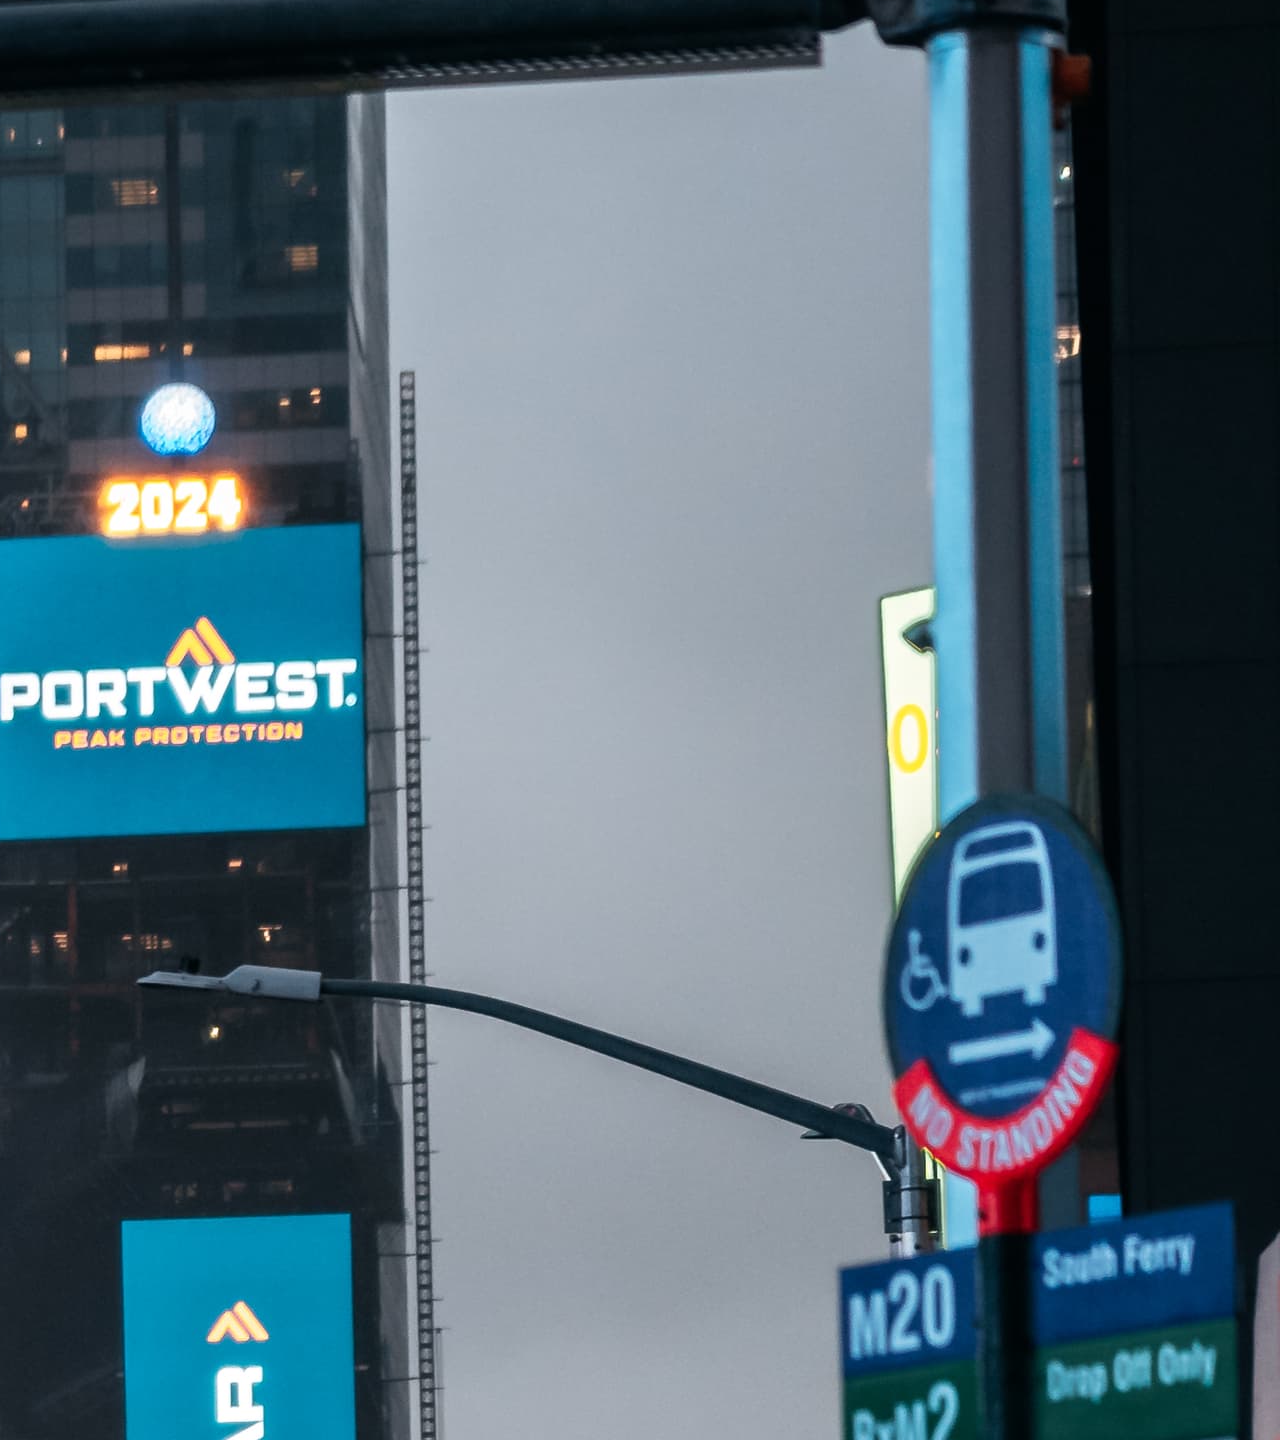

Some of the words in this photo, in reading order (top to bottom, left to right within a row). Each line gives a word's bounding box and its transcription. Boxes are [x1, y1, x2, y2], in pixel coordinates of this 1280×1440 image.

[106, 477, 243, 535] 2024
[54, 729, 125, 750] PEAK
[134, 722, 303, 748] PROTECTION
[908, 1085, 953, 1148] NO
[956, 1049, 1096, 1172] STANDING
[1042, 1243, 1119, 1289] South
[1122, 1233, 1195, 1276] Ferry
[848, 1264, 956, 1360] M20
[1046, 1360, 1109, 1405] Drop
[1112, 1348, 1153, 1393] Off
[1157, 1338, 1219, 1389] Only
